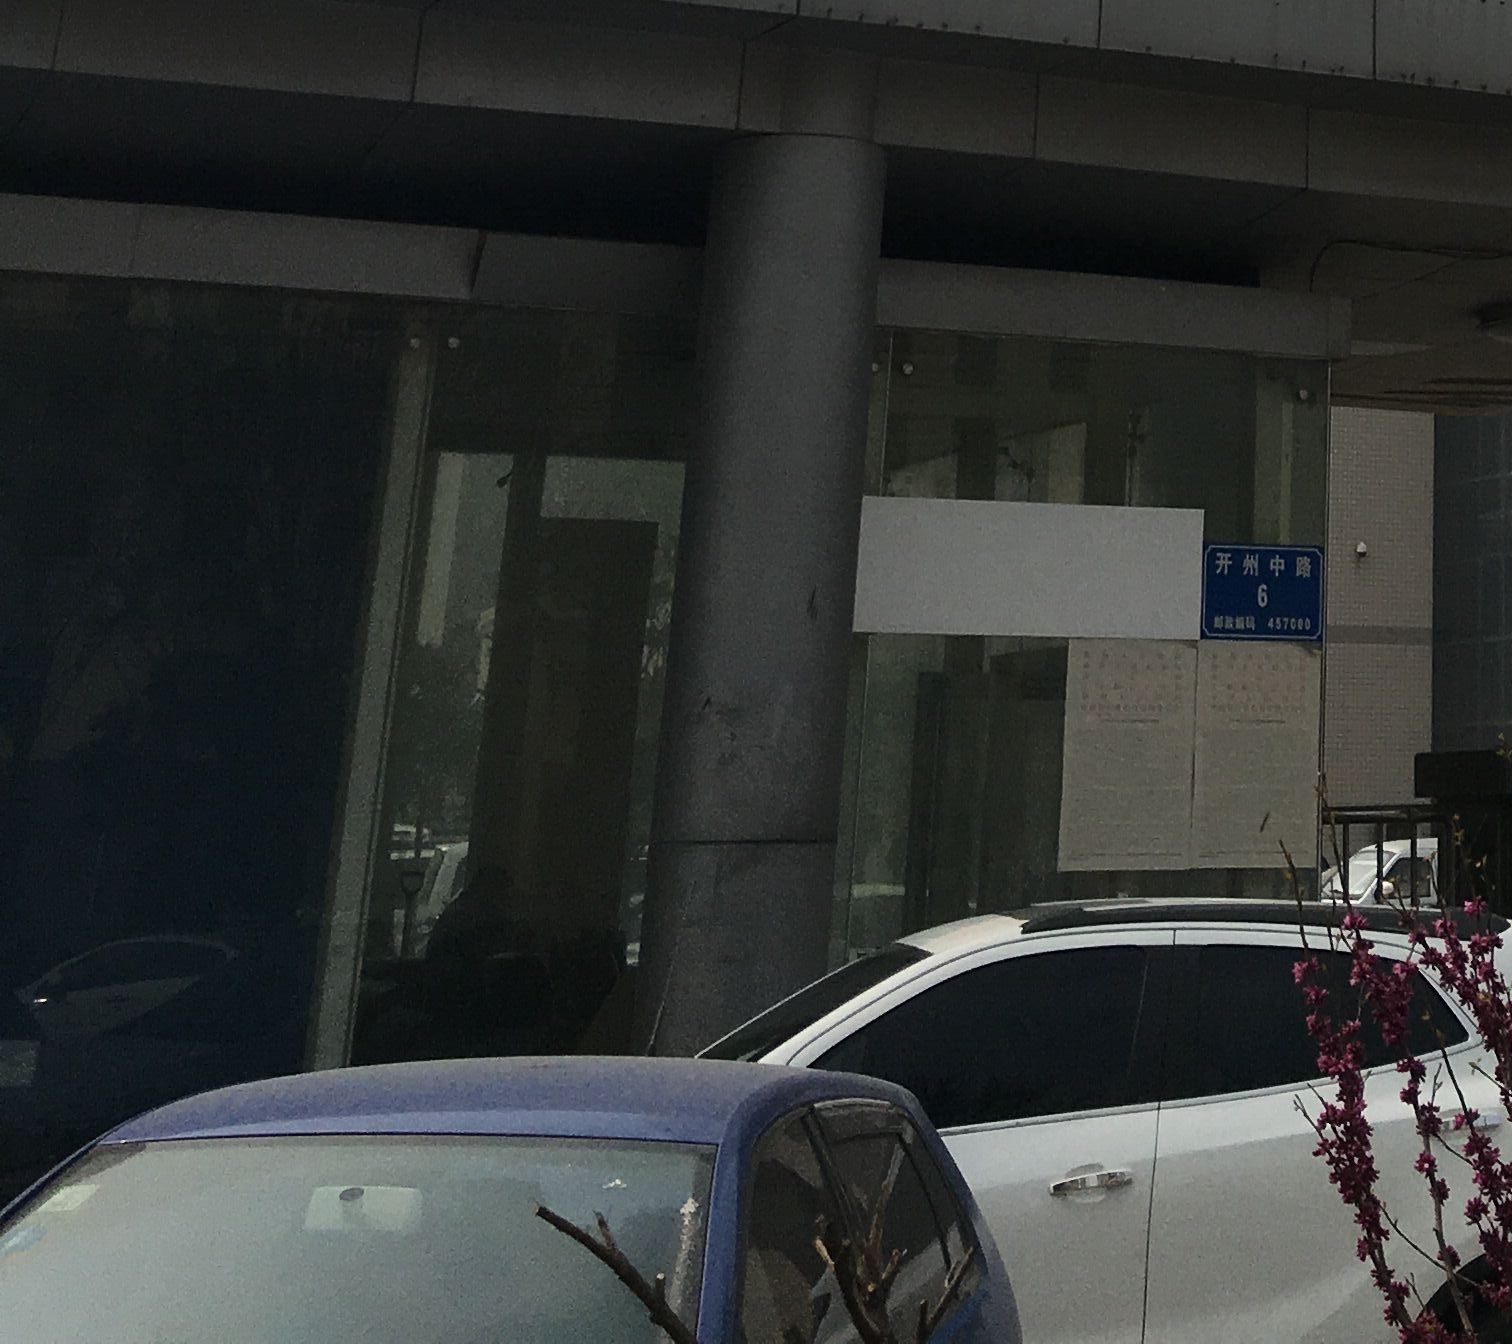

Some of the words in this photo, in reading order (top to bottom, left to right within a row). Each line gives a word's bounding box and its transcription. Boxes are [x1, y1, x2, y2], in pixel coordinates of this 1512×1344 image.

[1215, 552, 1312, 578] 开州中路
[1257, 583, 1268, 608] 6
[1213, 615, 1256, 631] 邮政编码
[1267, 616, 1312, 631] 457000
